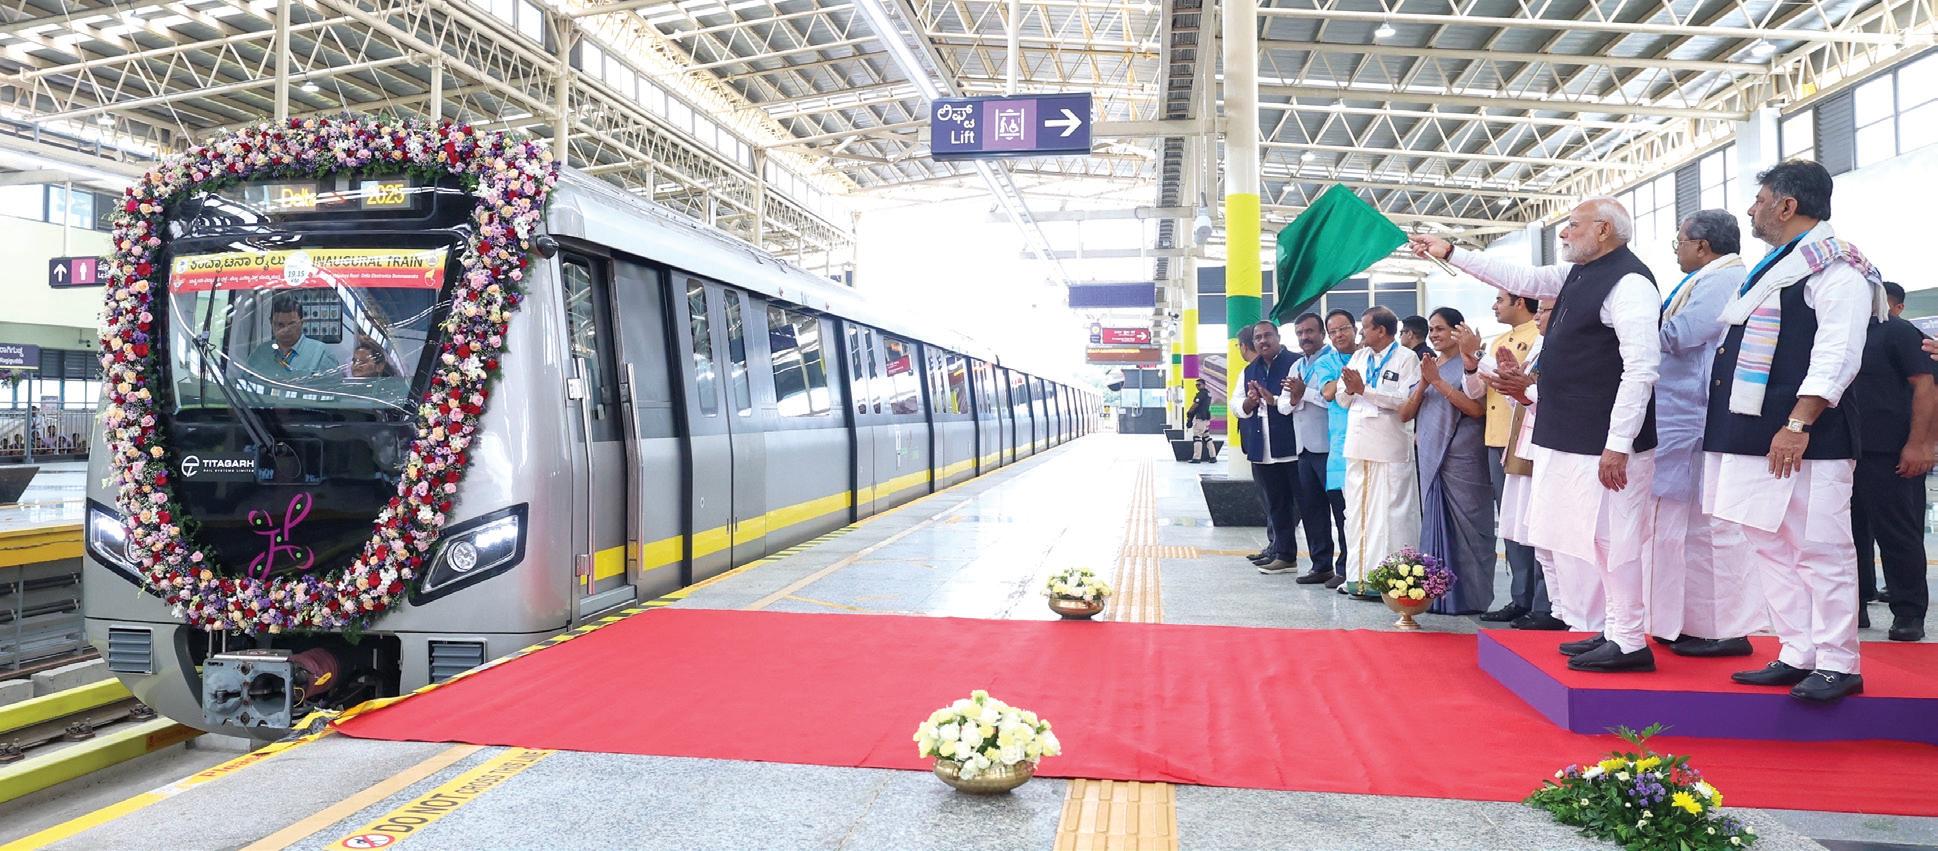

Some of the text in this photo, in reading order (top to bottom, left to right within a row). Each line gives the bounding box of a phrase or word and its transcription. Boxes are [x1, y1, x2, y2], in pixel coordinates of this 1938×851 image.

[937, 104, 975, 128] ಲಿಫ್ಟ್
[951, 130, 975, 144] Lift
[366, 184, 405, 204] 2025
[312, 255, 423, 267] INAUGURAL TRAIN
[202, 459, 255, 468] TITAGARH
[372, 816, 429, 833] DO
[404, 793, 471, 815] NOT
[454, 774, 505, 794] CROSS
[488, 762, 527, 773] THIS
